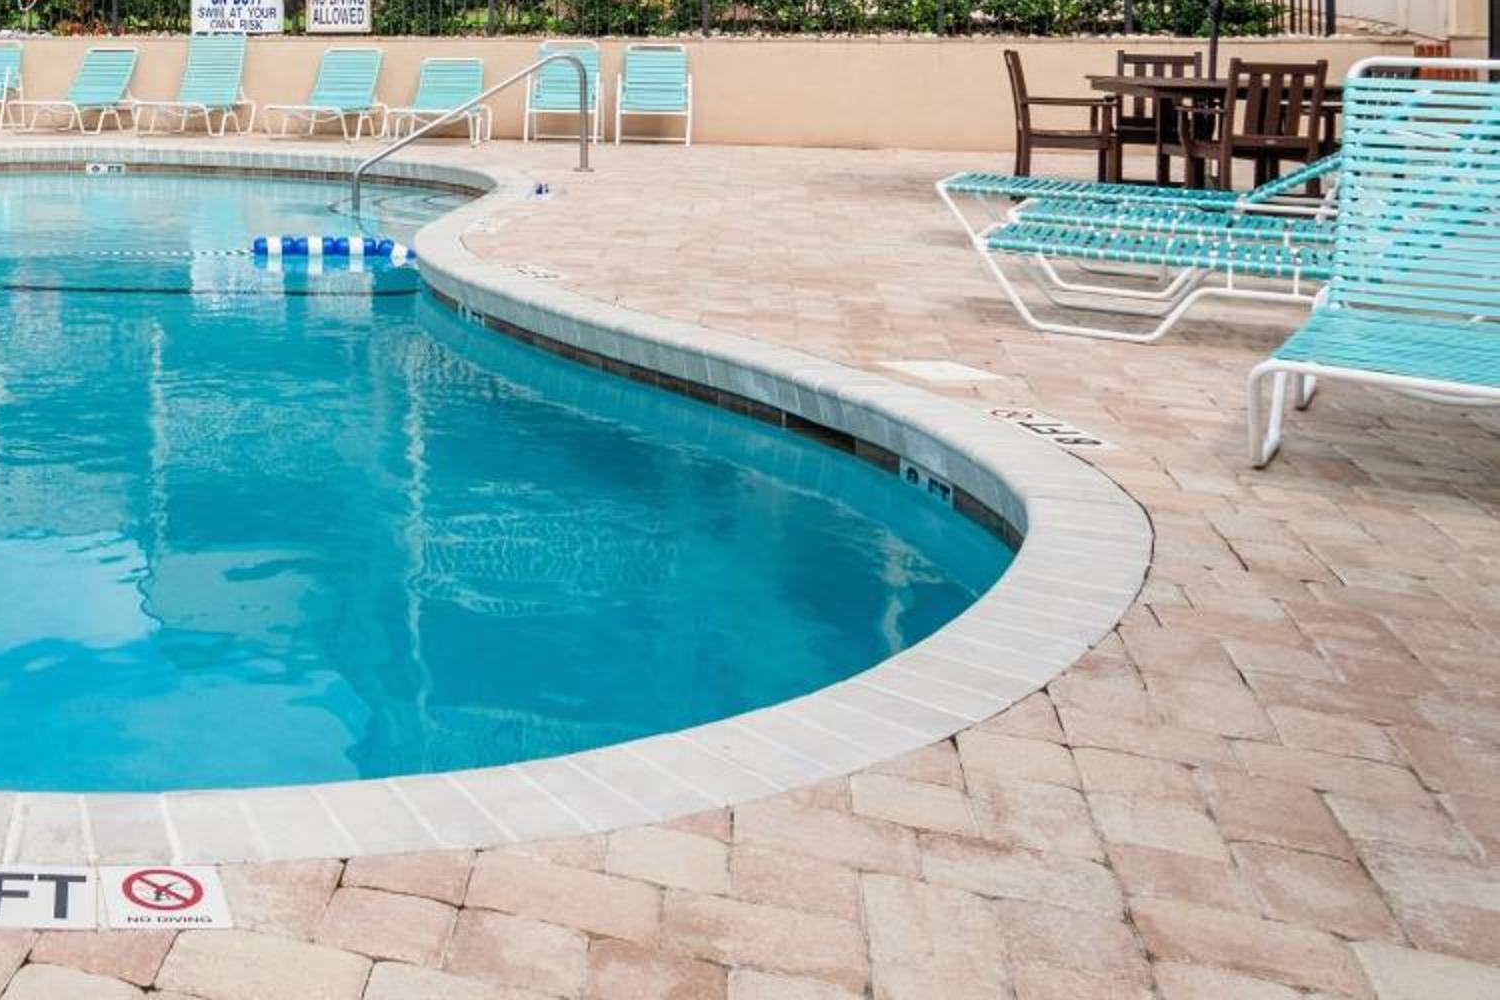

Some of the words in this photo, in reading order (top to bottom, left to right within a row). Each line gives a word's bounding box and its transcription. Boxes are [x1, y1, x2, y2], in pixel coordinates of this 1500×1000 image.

[198, 7, 225, 18] SWIM
[229, 7, 242, 18] AT
[248, 7, 277, 18] YOUR
[312, 7, 365, 24] ALLOWED
[210, 19, 235, 29] OWN
[240, 19, 263, 30] RISK
[127, 915, 151, 923] NO
[157, 915, 212, 923] DIVING
